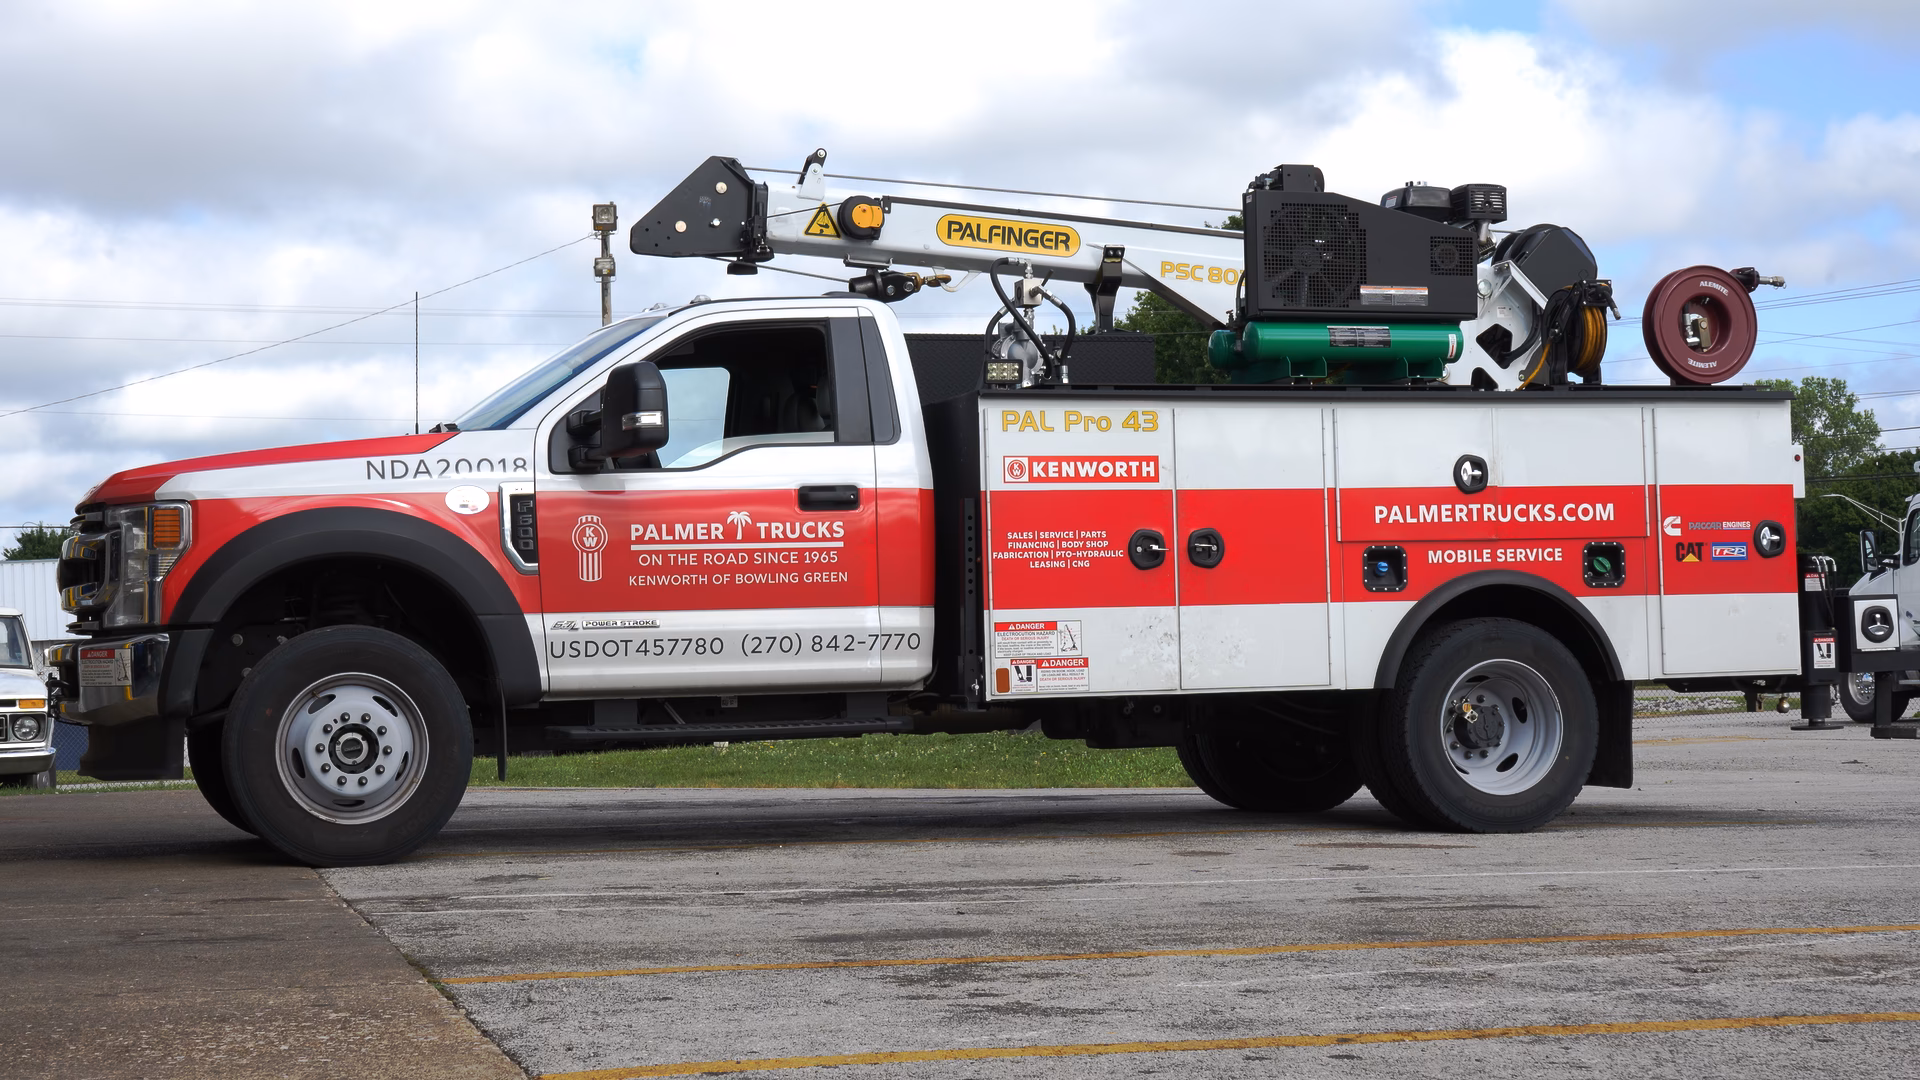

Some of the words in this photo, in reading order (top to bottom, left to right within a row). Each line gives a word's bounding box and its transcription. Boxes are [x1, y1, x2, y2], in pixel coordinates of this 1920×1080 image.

[946, 219, 1072, 252] PALFINGER
[1160, 260, 1203, 282] PSC
[1699, 280, 1729, 296] ALEMITE
[1001, 409, 1055, 433] PAL
[1064, 409, 1112, 433] Pro
[1121, 409, 1159, 433] 43
[366, 457, 528, 481] NDA20018
[1032, 461, 1155, 478] KENWORTH
[1374, 503, 1615, 524] PALMERTRUCKS.COM
[630, 523, 725, 541] PALMER
[756, 521, 845, 540] TRUCKS
[1688, 521, 1722, 530] PACCAR
[1007, 531, 1033, 539] SALES
[1039, 531, 1074, 539] SERVICE
[1080, 530, 1107, 538] PARTS
[1007, 541, 1055, 549] FINANCING
[1085, 540, 1109, 548] SHOP
[1675, 541, 1704, 562] CAT
[1713, 546, 1746, 556] TRP
[638, 553, 663, 567] ON
[668, 552, 698, 566] THE
[703, 552, 749, 565] ROAD
[753, 551, 799, 564] SINCE
[804, 550, 838, 563] 1965
[992, 551, 1049, 559] FABRICATION
[1055, 550, 1124, 558] PTO-HYDRAULIC
[1427, 549, 1492, 564] MOBILE
[1496, 547, 1563, 562] SERVICE
[1030, 560, 1066, 569] LEASING
[1072, 560, 1090, 568] CNG
[629, 574, 708, 587] KENWORTH
[712, 573, 731, 585] OF
[735, 572, 799, 584] BOWLING
[803, 571, 848, 583] GREEN
[550, 637, 724, 659] USDOT457780
[740, 633, 802, 657] (270)
[811, 632, 921, 653] 842-7770
[1050, 659, 1084, 667] DANGER
